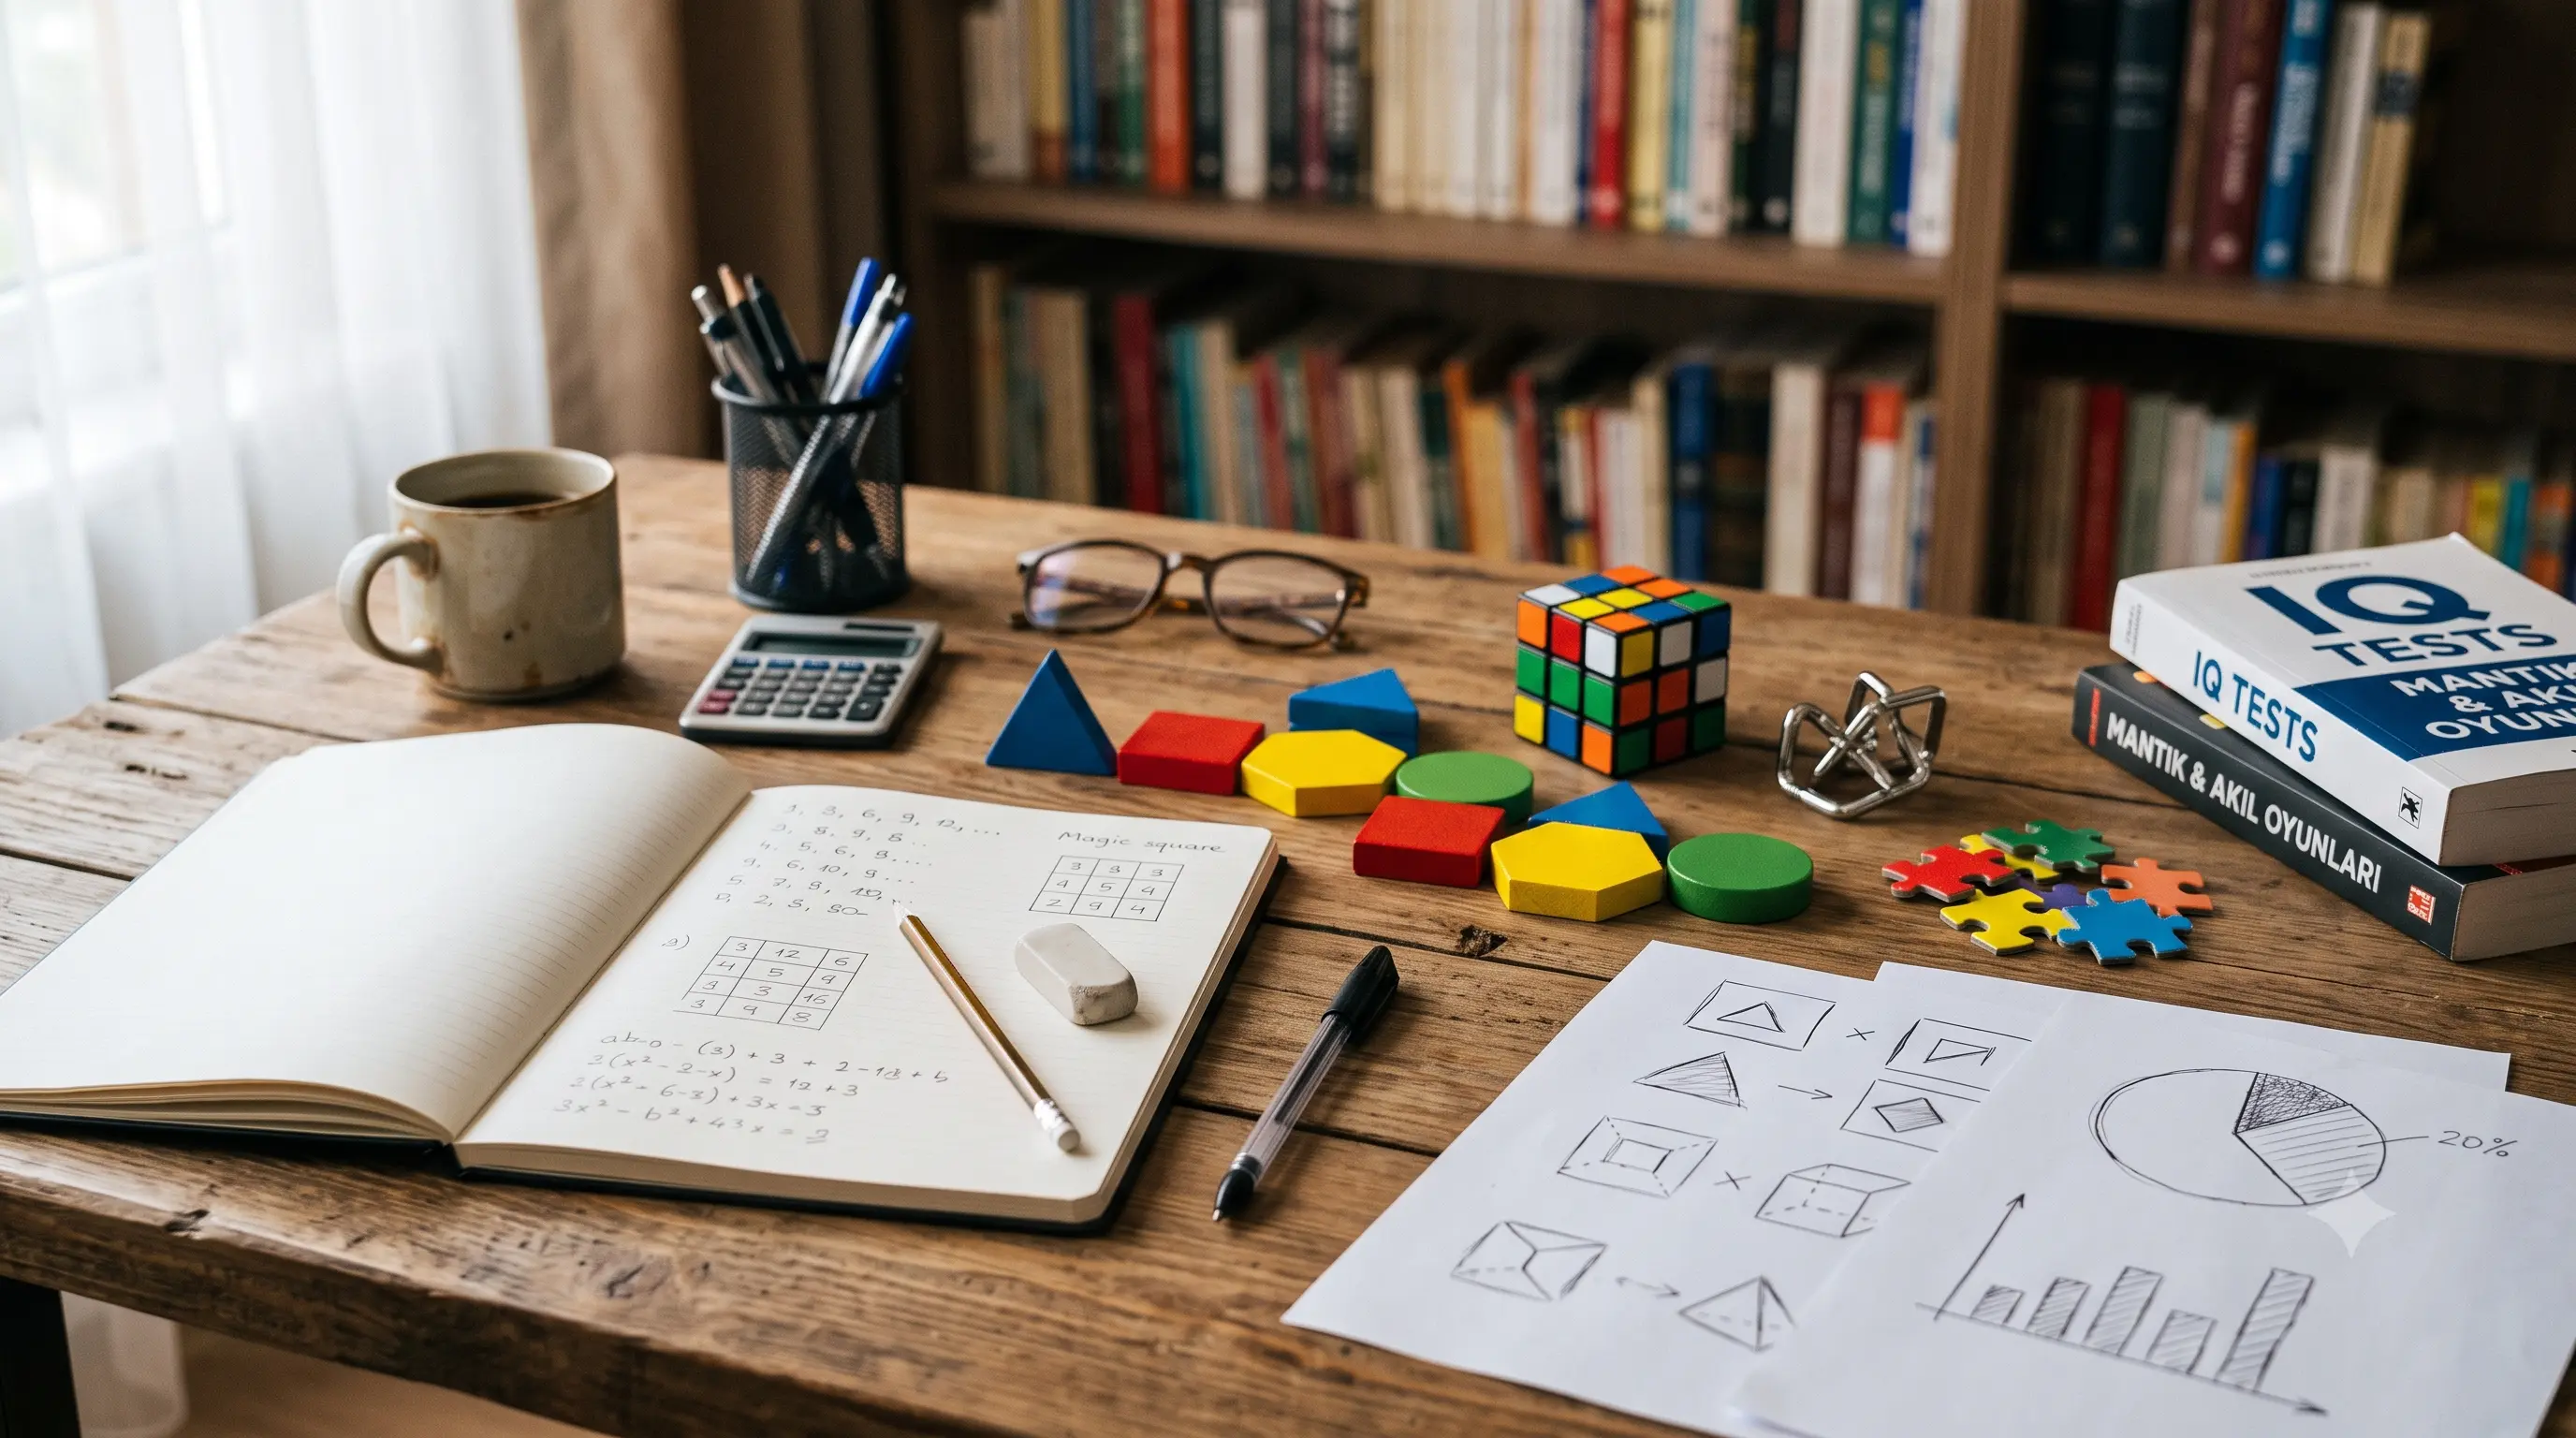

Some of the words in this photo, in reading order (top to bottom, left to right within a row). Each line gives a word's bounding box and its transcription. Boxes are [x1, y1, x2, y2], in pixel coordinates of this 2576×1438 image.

[2245, 576, 2491, 636] IQ
[2312, 624, 2557, 667] TESTS
[2389, 662, 2576, 697] MANTIK
[2193, 650, 2222, 702] IQ
[2232, 672, 2318, 763] TESTS
[2449, 695, 2494, 713] &
[2425, 708, 2576, 739] OYUN
[2107, 712, 2188, 783] MANTIK
[2189, 761, 2207, 794] &
[2209, 773, 2259, 825] AKIL
[2264, 803, 2382, 894] OYUNLARI
[1058, 831, 1132, 848] Magic
[1144, 840, 1228, 854] square
[1056, 879, 1069, 888] 4
[1100, 882, 1116, 892] 5
[1141, 886, 1156, 896] 4
[1046, 899, 1062, 907] 2
[1089, 901, 1103, 911] 9
[1131, 904, 1146, 915] 4
[775, 948, 800, 960] 12
[834, 957, 850, 966] 6
[768, 967, 783, 977] 5
[804, 993, 829, 1005] 16
[792, 1012, 812, 1022] 8
[2438, 1130, 2518, 1157] 20%
